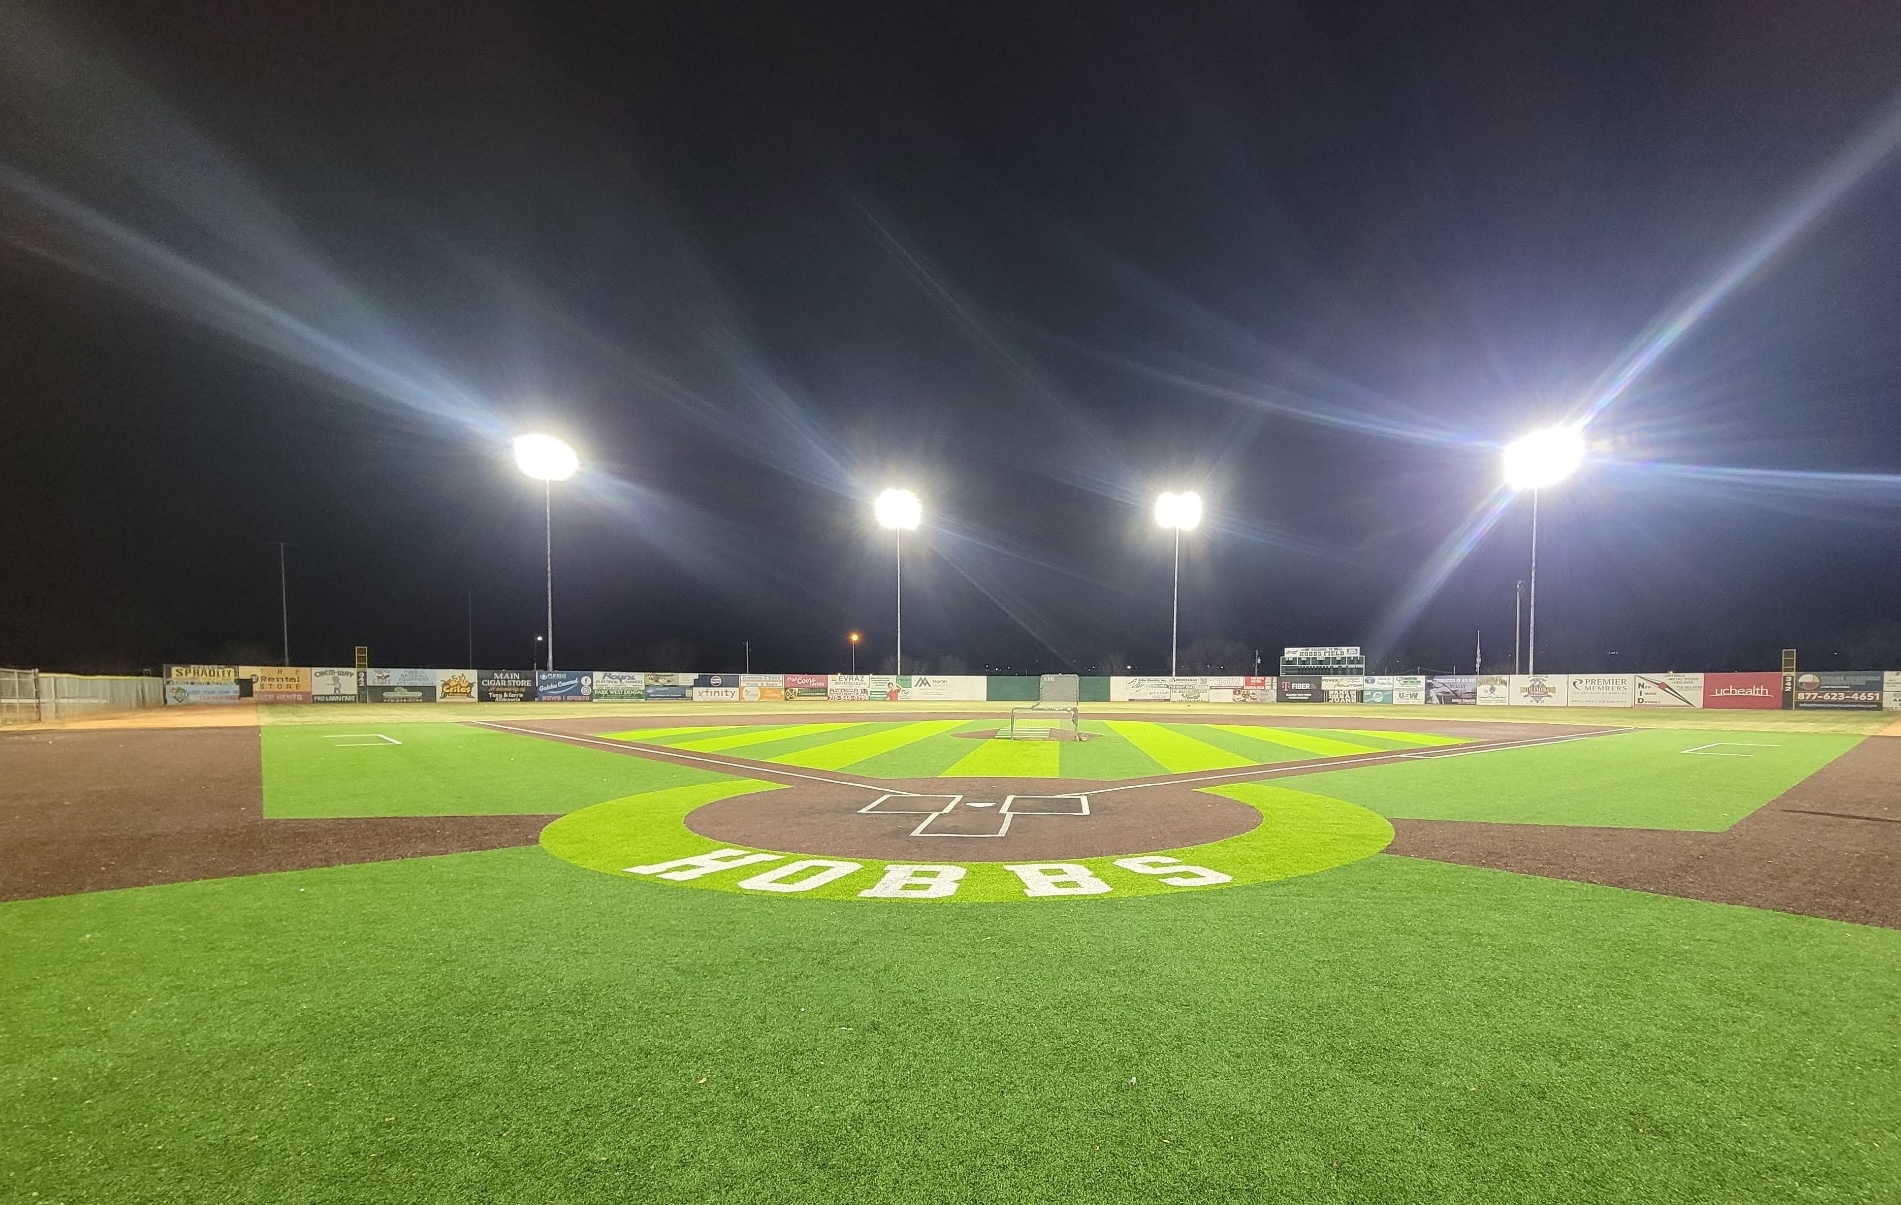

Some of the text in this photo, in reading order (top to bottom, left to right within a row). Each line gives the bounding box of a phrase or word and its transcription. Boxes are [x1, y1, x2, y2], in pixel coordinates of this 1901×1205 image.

[175, 669, 231, 677] SPRADLEY
[314, 670, 355, 678] CHEM-WAY
[493, 672, 520, 680] MAIN
[507, 679, 532, 687] STORE
[1585, 678, 1627, 686] PREMIER
[698, 689, 736, 698] xfinity
[1715, 685, 1768, 695] uchealth
[1798, 692, 1880, 701] 877-623-4651
[624, 848, 1233, 899] HOBBS
